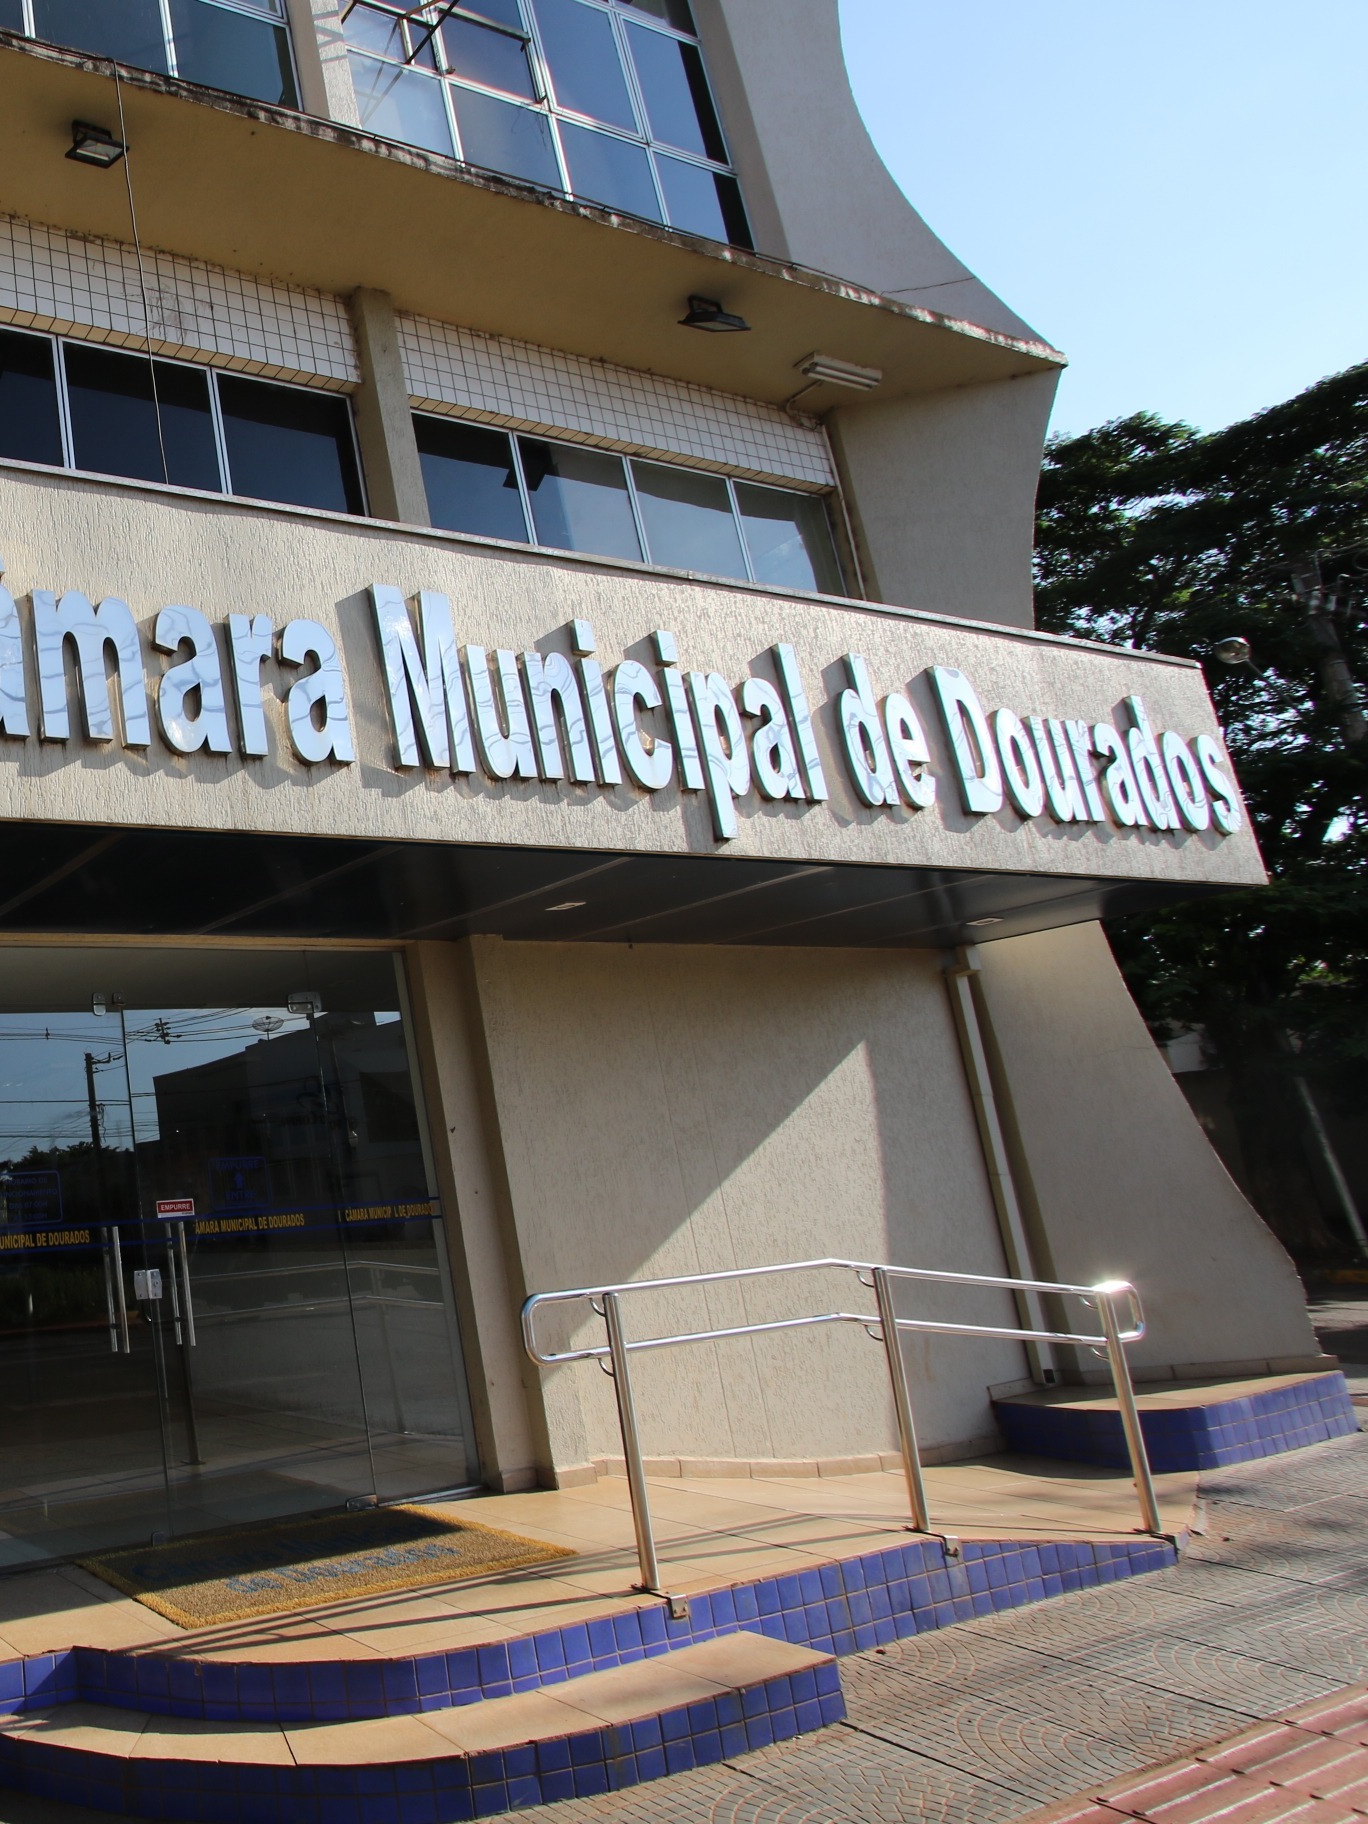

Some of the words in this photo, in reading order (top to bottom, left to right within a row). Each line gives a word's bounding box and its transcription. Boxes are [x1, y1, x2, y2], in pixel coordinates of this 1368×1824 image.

[368, 582, 828, 840] Municipal
[837, 652, 936, 811] de
[926, 665, 1243, 836] Dourados
[160, 1203, 191, 1211] EMPURRE
[369, 1205, 399, 1220] MUNICIPL
[399, 1204, 407, 1217] DE
[220, 1217, 258, 1233] MUNICIPAL
[258, 1216, 268, 1230] DE
[268, 1213, 305, 1229] DOURADOS
[36, 1232, 47, 1247] DE
[48, 1229, 91, 1245] DOURADOS
[226, 1575, 282, 1594] de
[272, 1542, 460, 1584] Dourados
